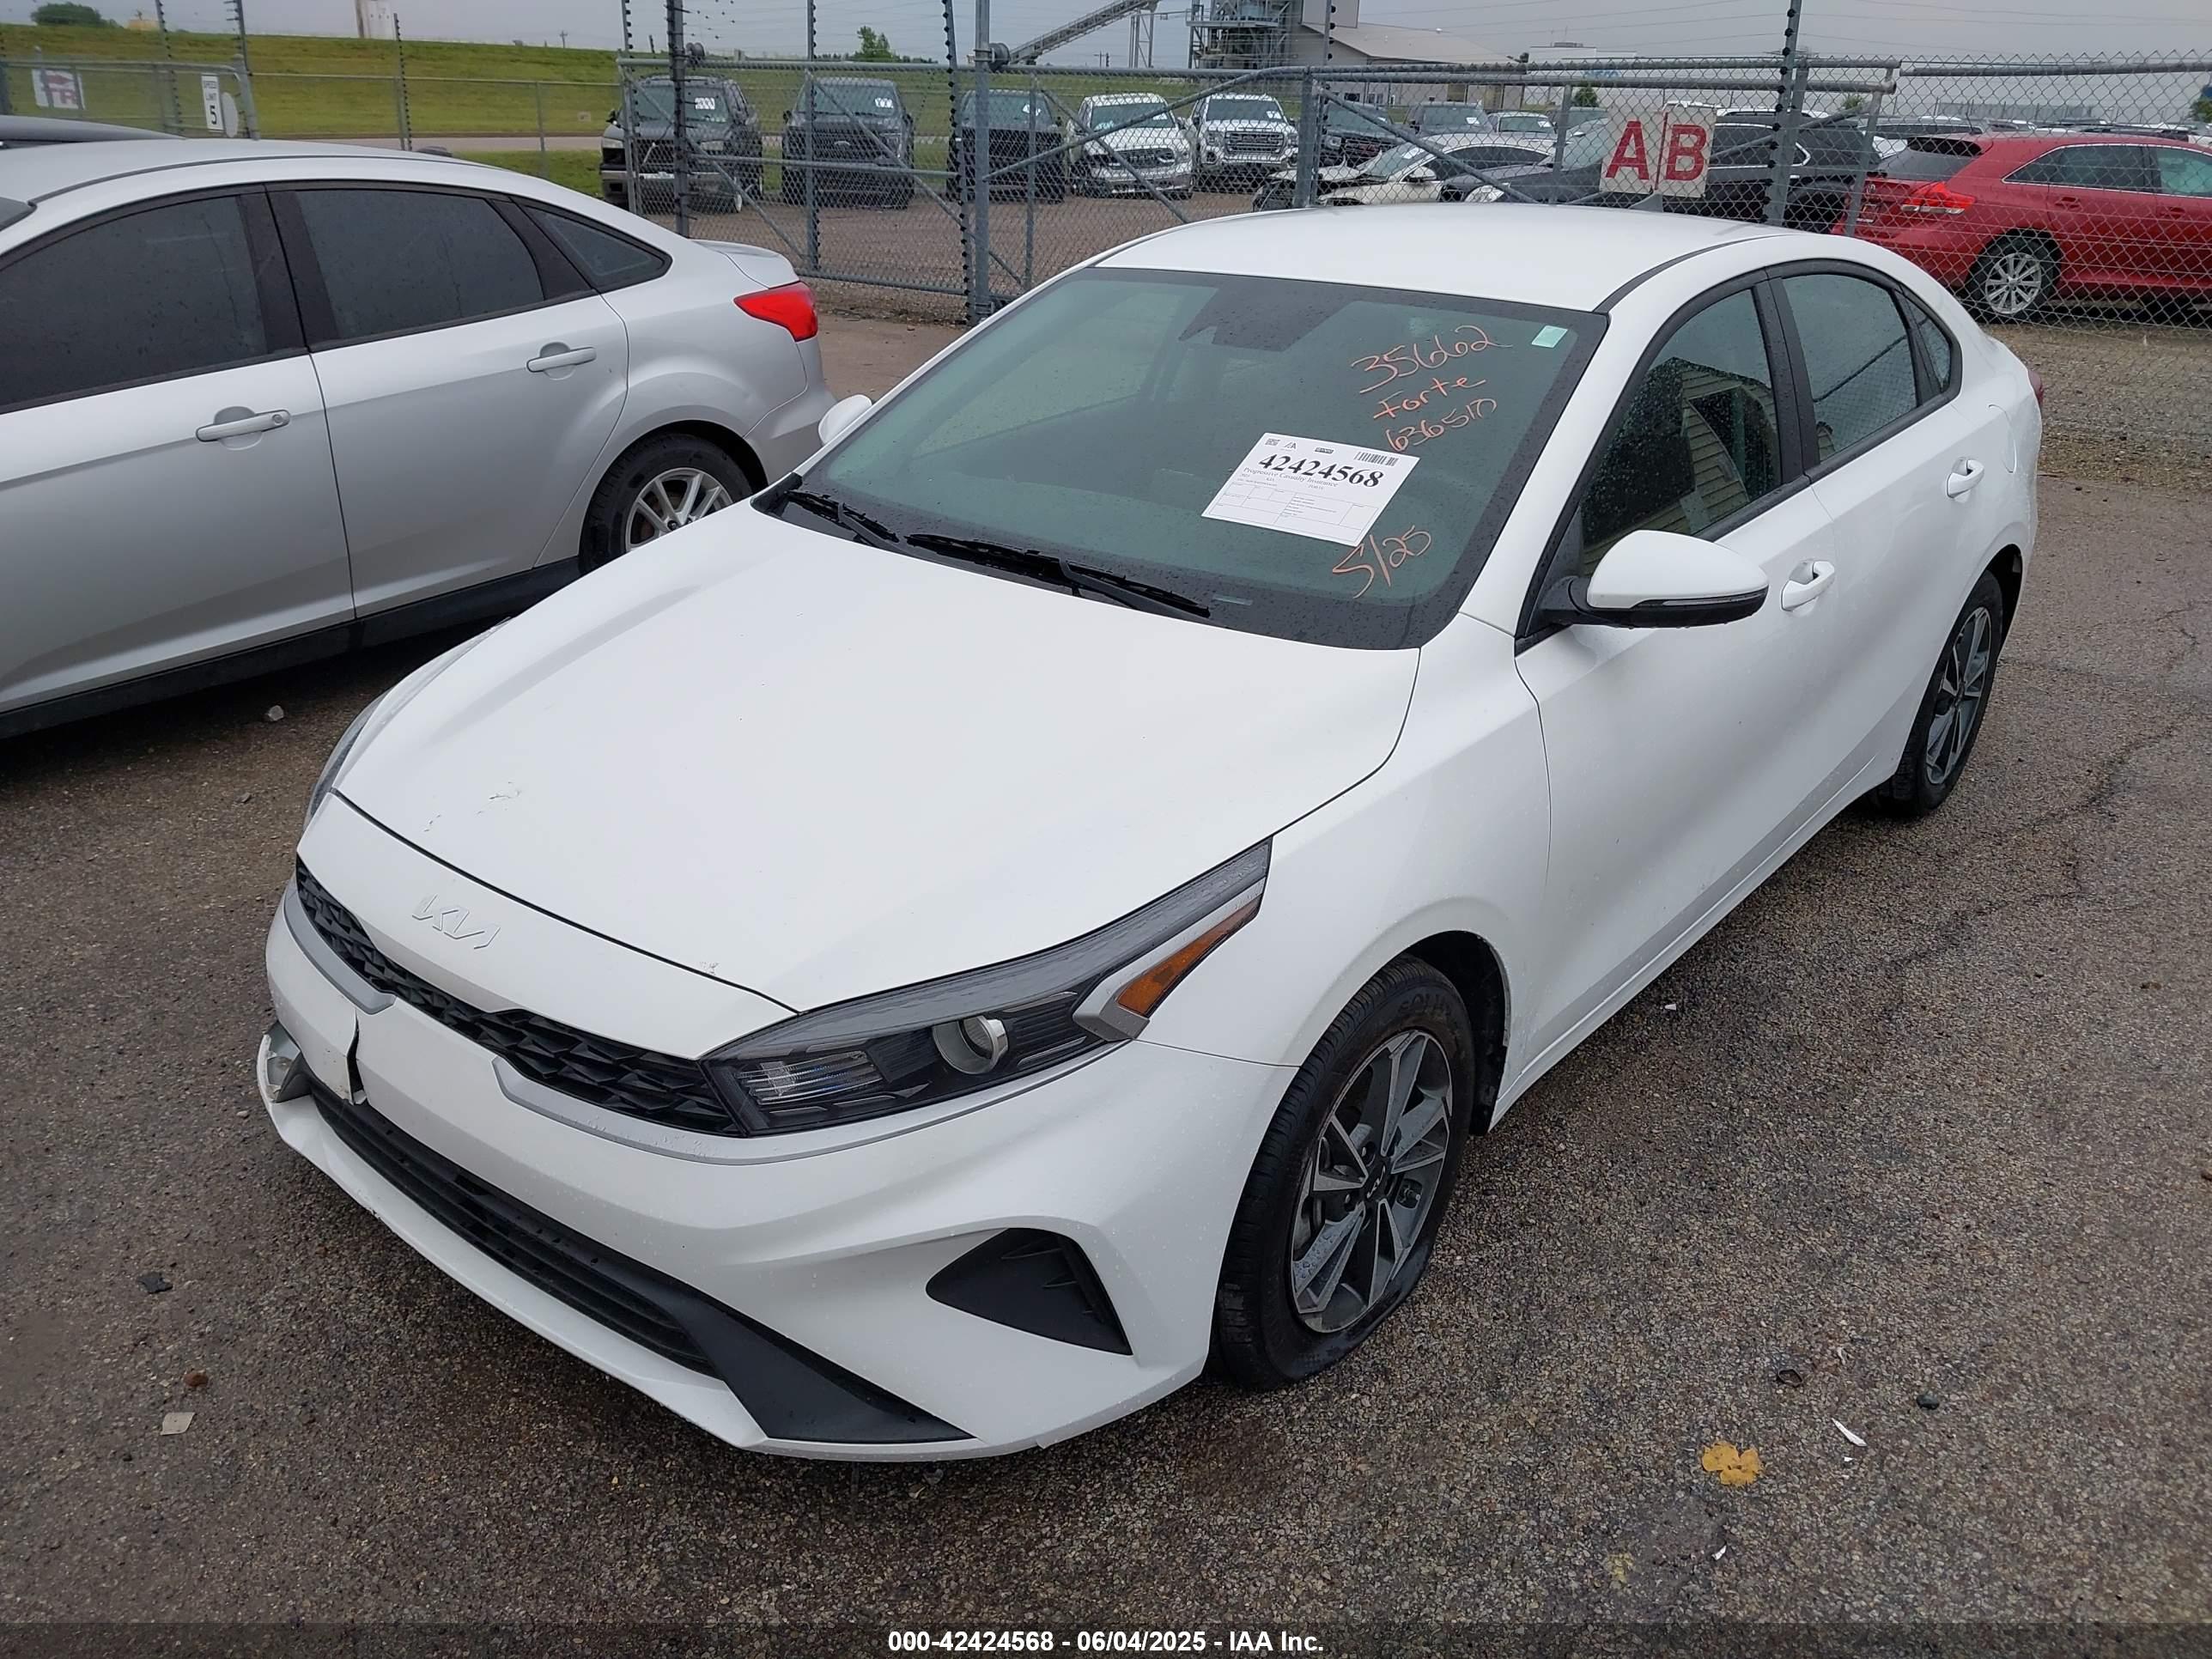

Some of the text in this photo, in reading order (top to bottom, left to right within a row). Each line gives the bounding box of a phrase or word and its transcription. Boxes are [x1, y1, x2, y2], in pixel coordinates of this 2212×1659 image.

[210, 105, 217, 125] 5
[1605, 120, 1650, 180] A
[1665, 124, 1707, 181] B
[1350, 325, 1513, 394] 35662
[1243, 467, 1279, 477] Progressive
[1279, 472, 1307, 483] Casualty
[1257, 453, 1385, 488] 42424568
[1332, 525, 1432, 599] 5/25
[411, 893, 501, 950] KIA
